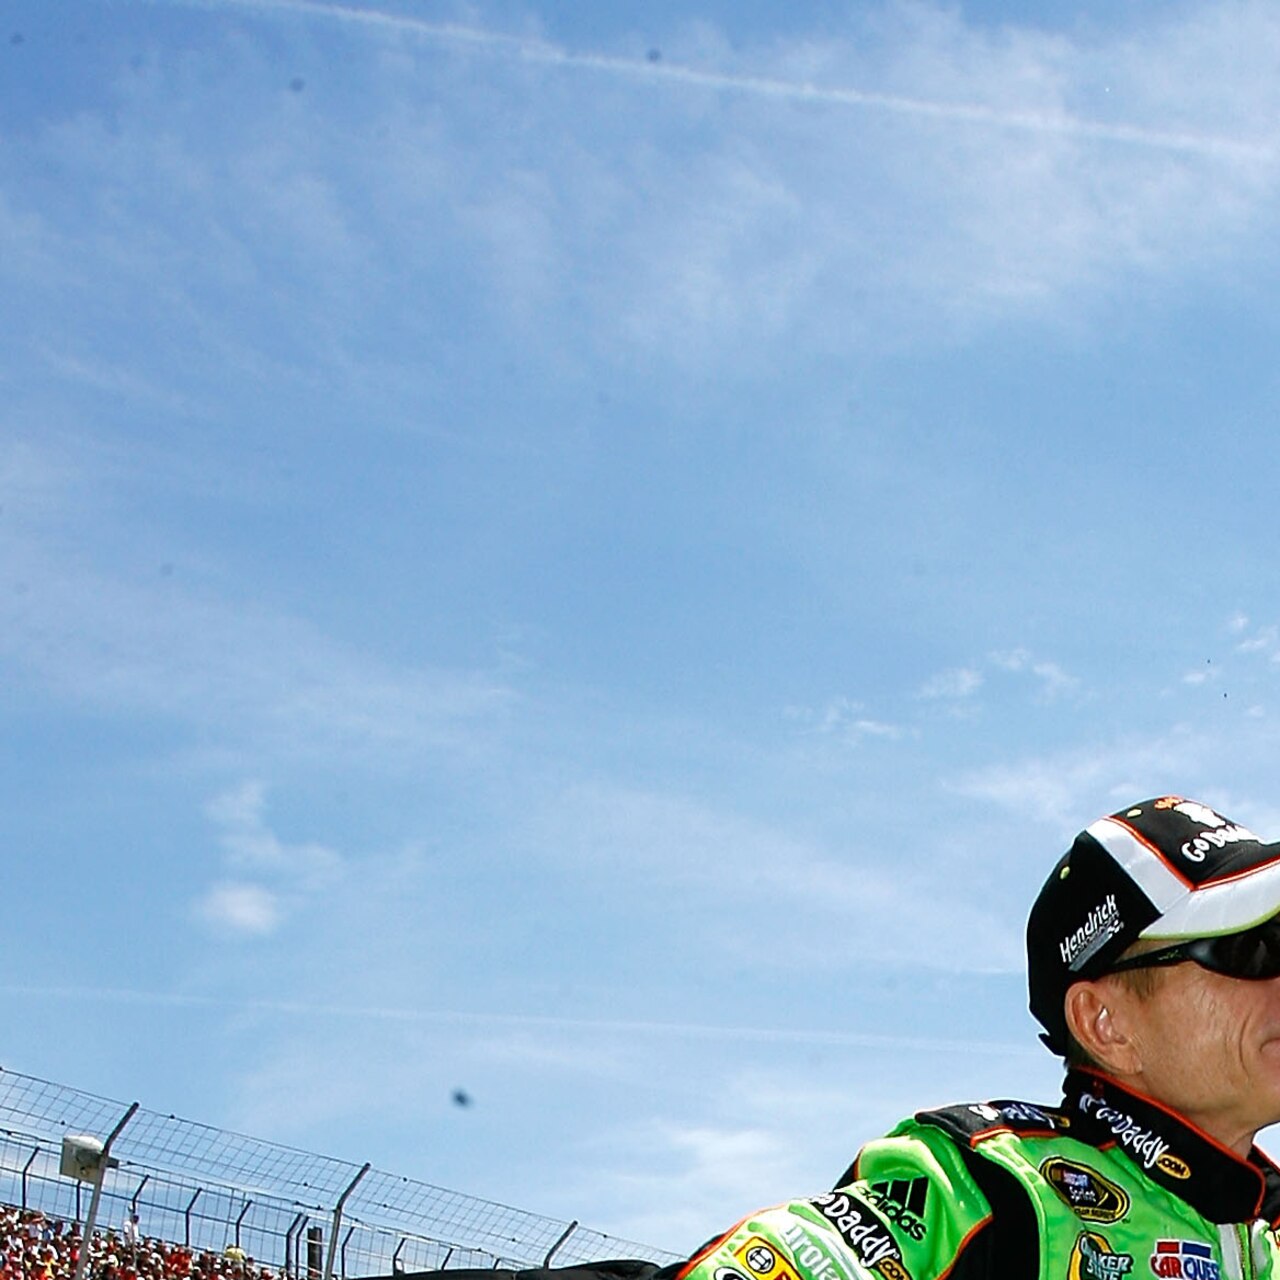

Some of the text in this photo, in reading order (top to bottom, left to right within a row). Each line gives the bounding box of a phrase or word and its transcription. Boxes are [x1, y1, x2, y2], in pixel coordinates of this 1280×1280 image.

[1059, 893, 1118, 963] Hendrick
[857, 1185, 927, 1242] adidas
[1080, 1236, 1130, 1272] QAKER
